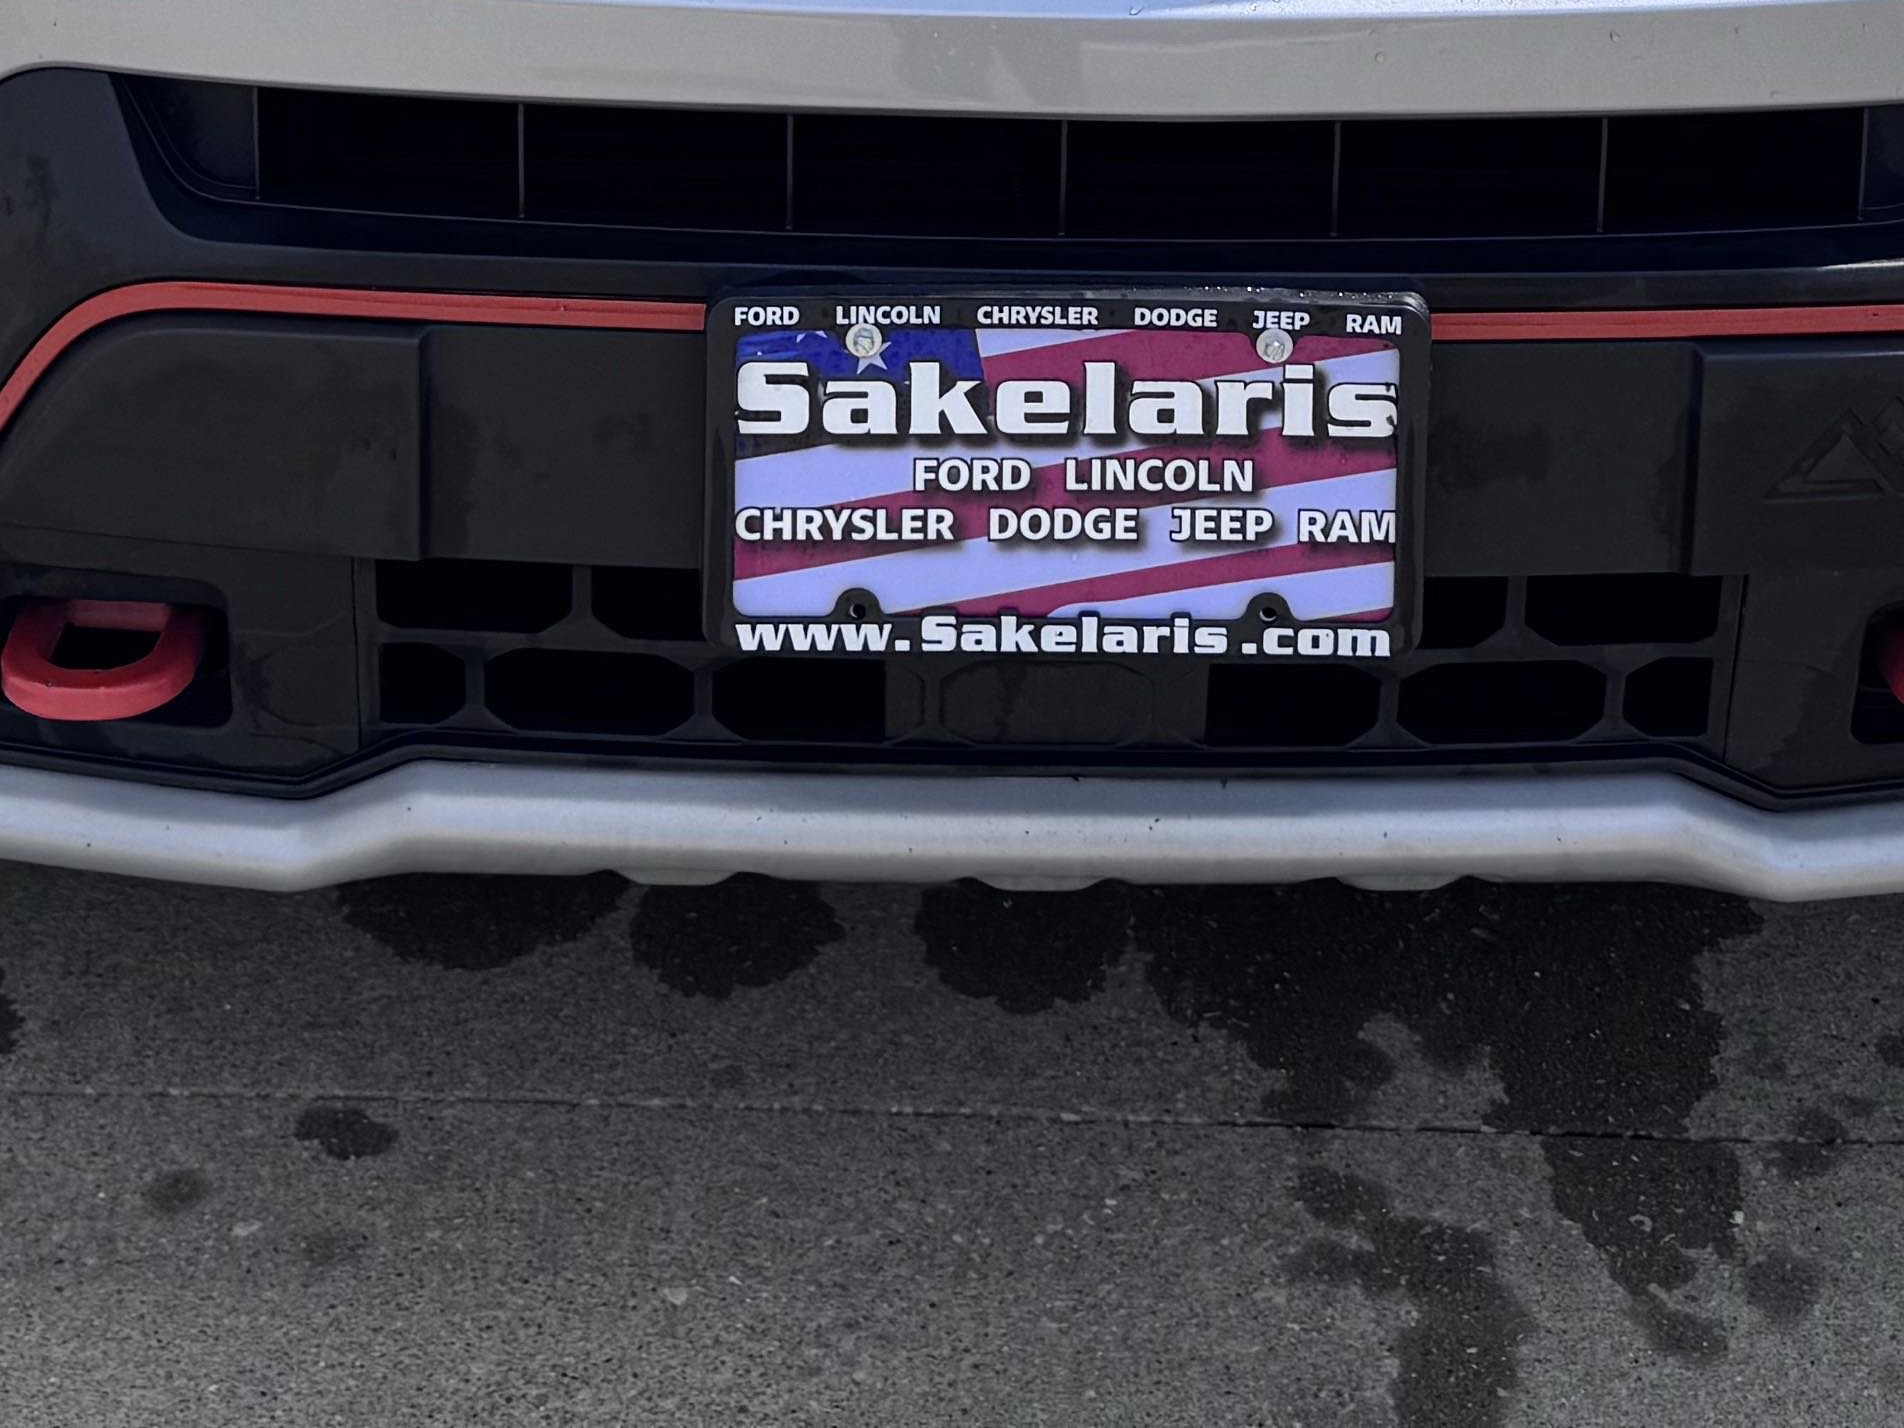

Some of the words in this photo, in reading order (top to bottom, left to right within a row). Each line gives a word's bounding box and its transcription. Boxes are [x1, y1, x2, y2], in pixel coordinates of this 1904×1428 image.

[734, 306, 800, 326] FORD
[835, 306, 941, 325] LINCOLN
[976, 306, 1099, 326] CHRYSLER
[1134, 307, 1218, 328] DODGE
[1252, 310, 1311, 331] JEEP
[1345, 314, 1402, 335] RAM
[736, 361, 1397, 438] Sakelaris
[914, 459, 1031, 492] FORD
[1065, 459, 1254, 493] LINCOLN
[735, 507, 954, 541] CHRYSLER
[988, 508, 1138, 541] DODGE
[1169, 508, 1274, 542] JEEP
[1298, 510, 1396, 544] RAM
